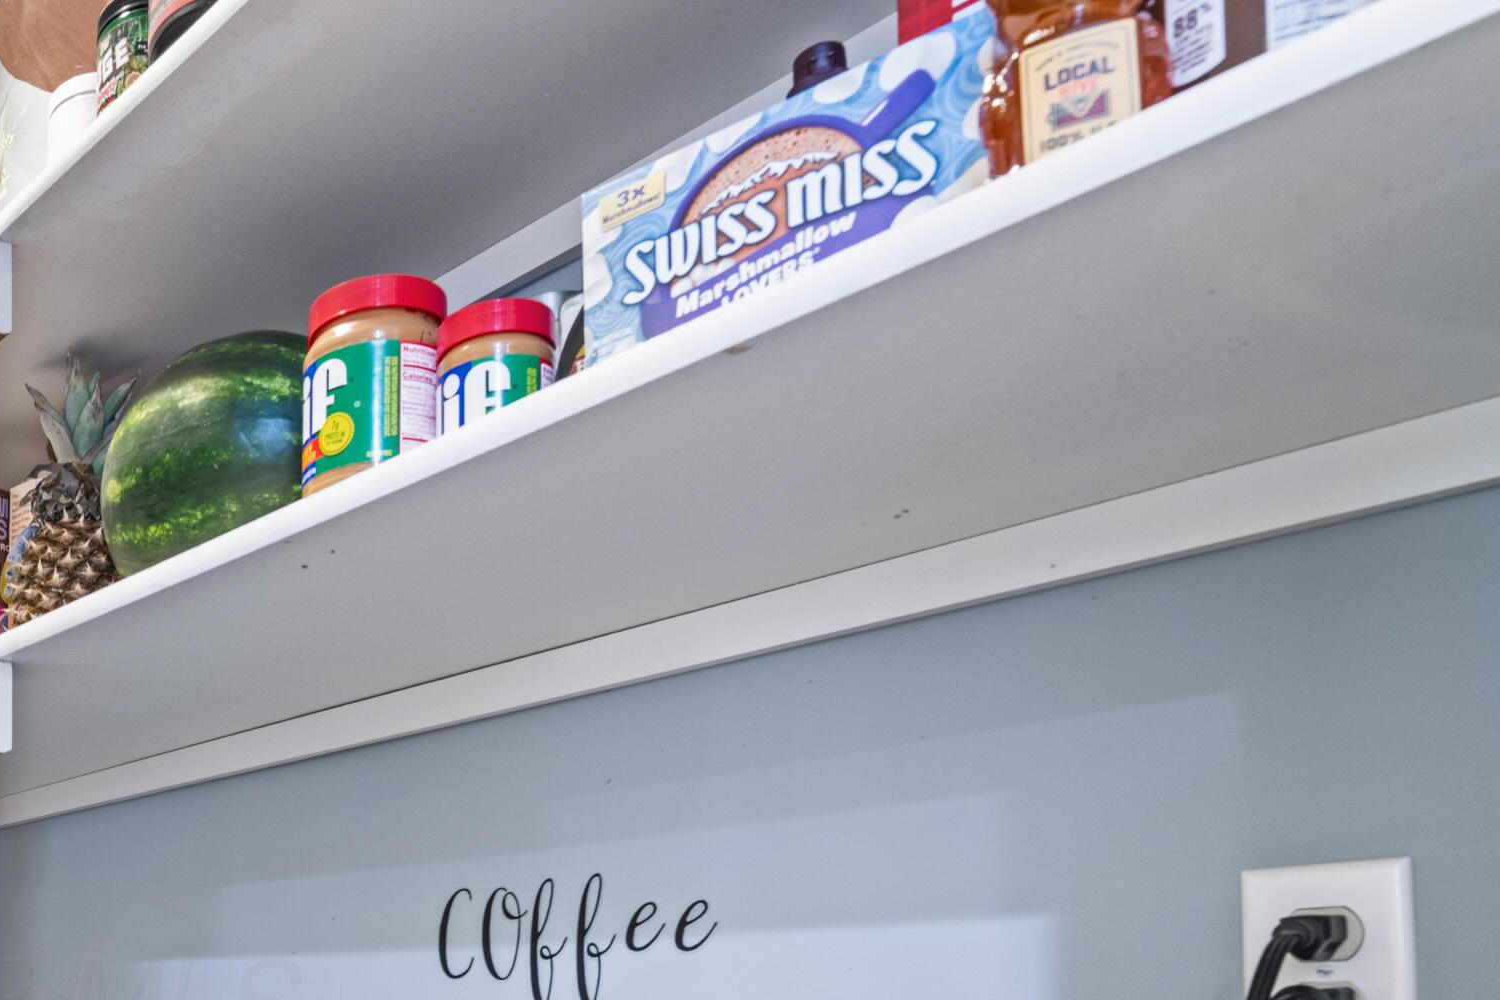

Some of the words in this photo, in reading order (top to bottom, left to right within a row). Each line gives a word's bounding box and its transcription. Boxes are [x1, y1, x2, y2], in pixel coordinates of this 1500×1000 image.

[1044, 57, 1115, 92] LOCAL
[616, 182, 646, 207] 3x
[623, 190, 778, 305] SWISS
[787, 120, 937, 229] MISS
[675, 212, 858, 319] Marshmallow
[720, 250, 817, 307] LOVERS
[403, 371, 433, 383] Calories
